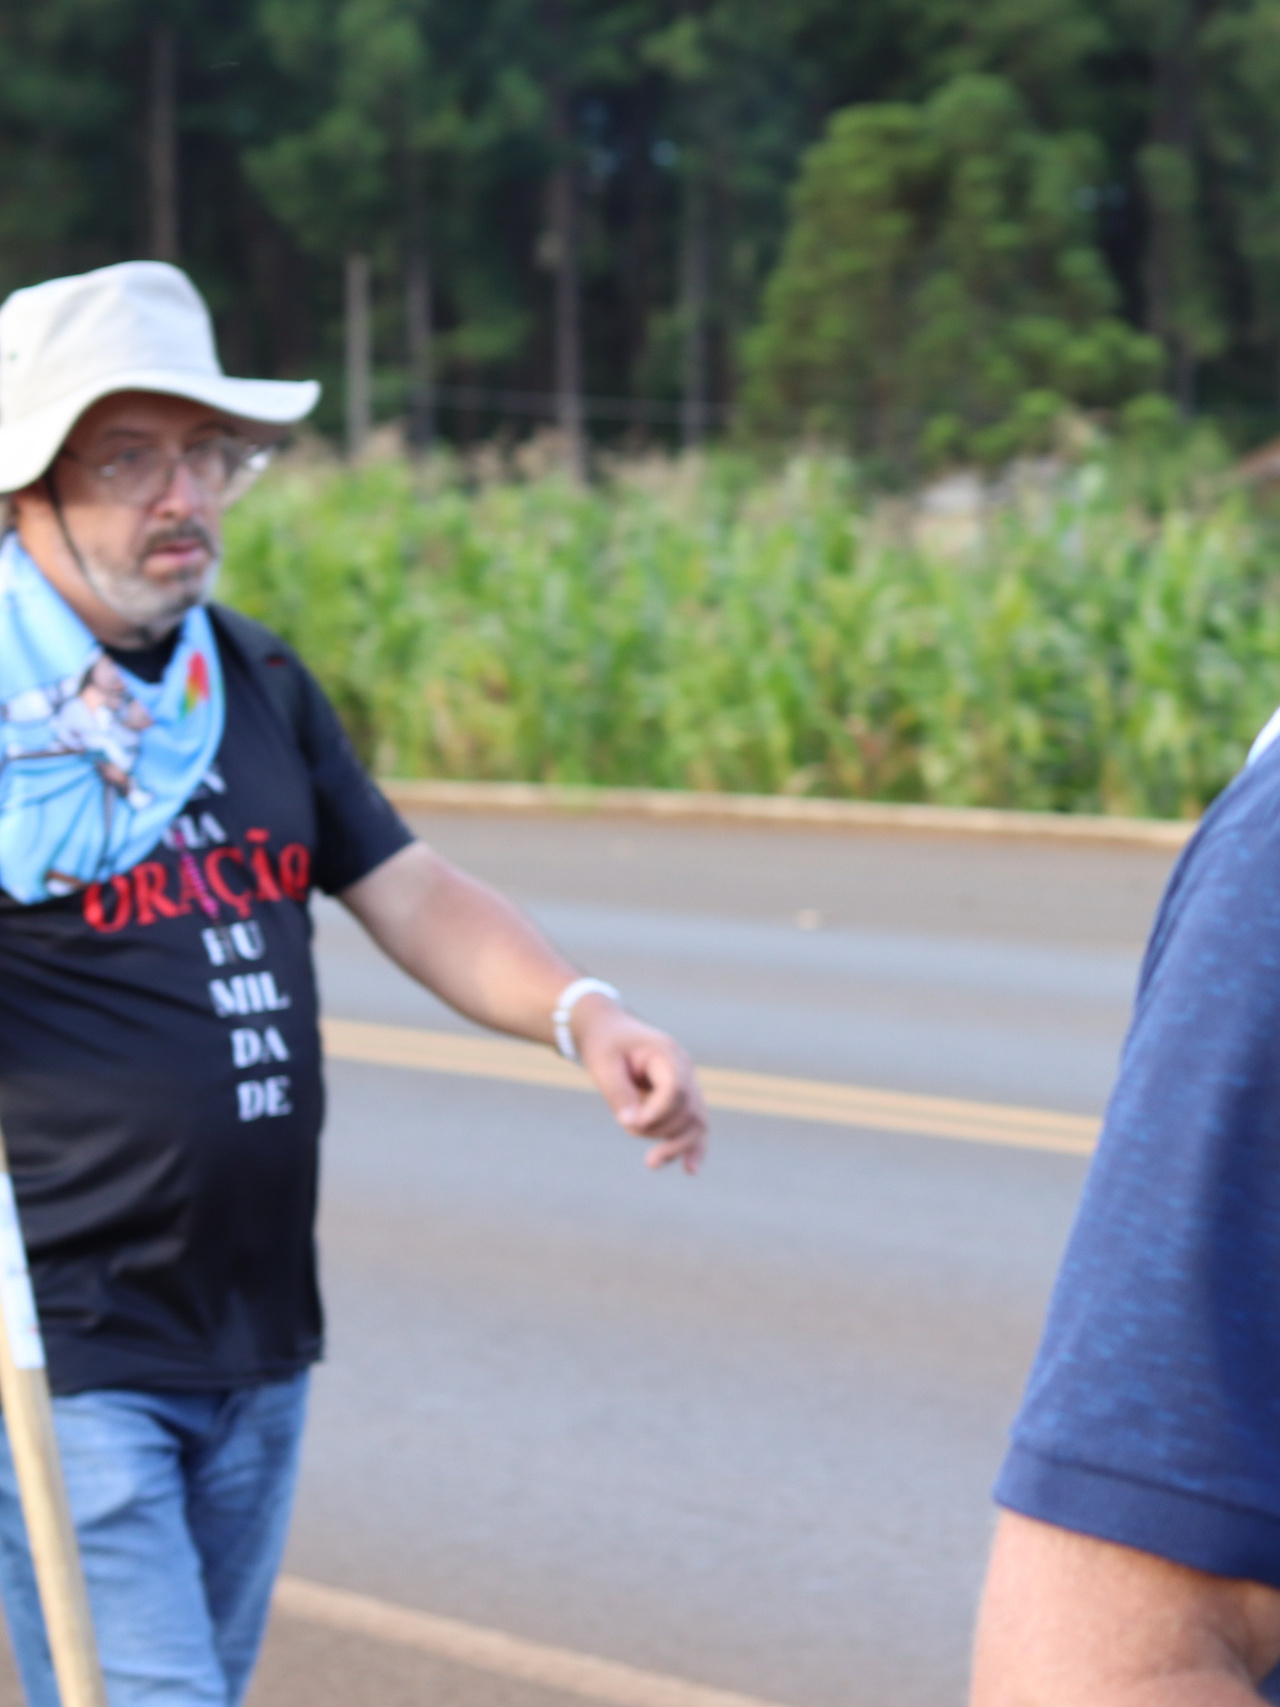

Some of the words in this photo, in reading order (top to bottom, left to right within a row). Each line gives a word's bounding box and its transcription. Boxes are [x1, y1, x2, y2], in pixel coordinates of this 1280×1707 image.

[209, 972, 291, 1017] MIL
[231, 1026, 289, 1068] DA
[237, 1075, 292, 1121] DE
